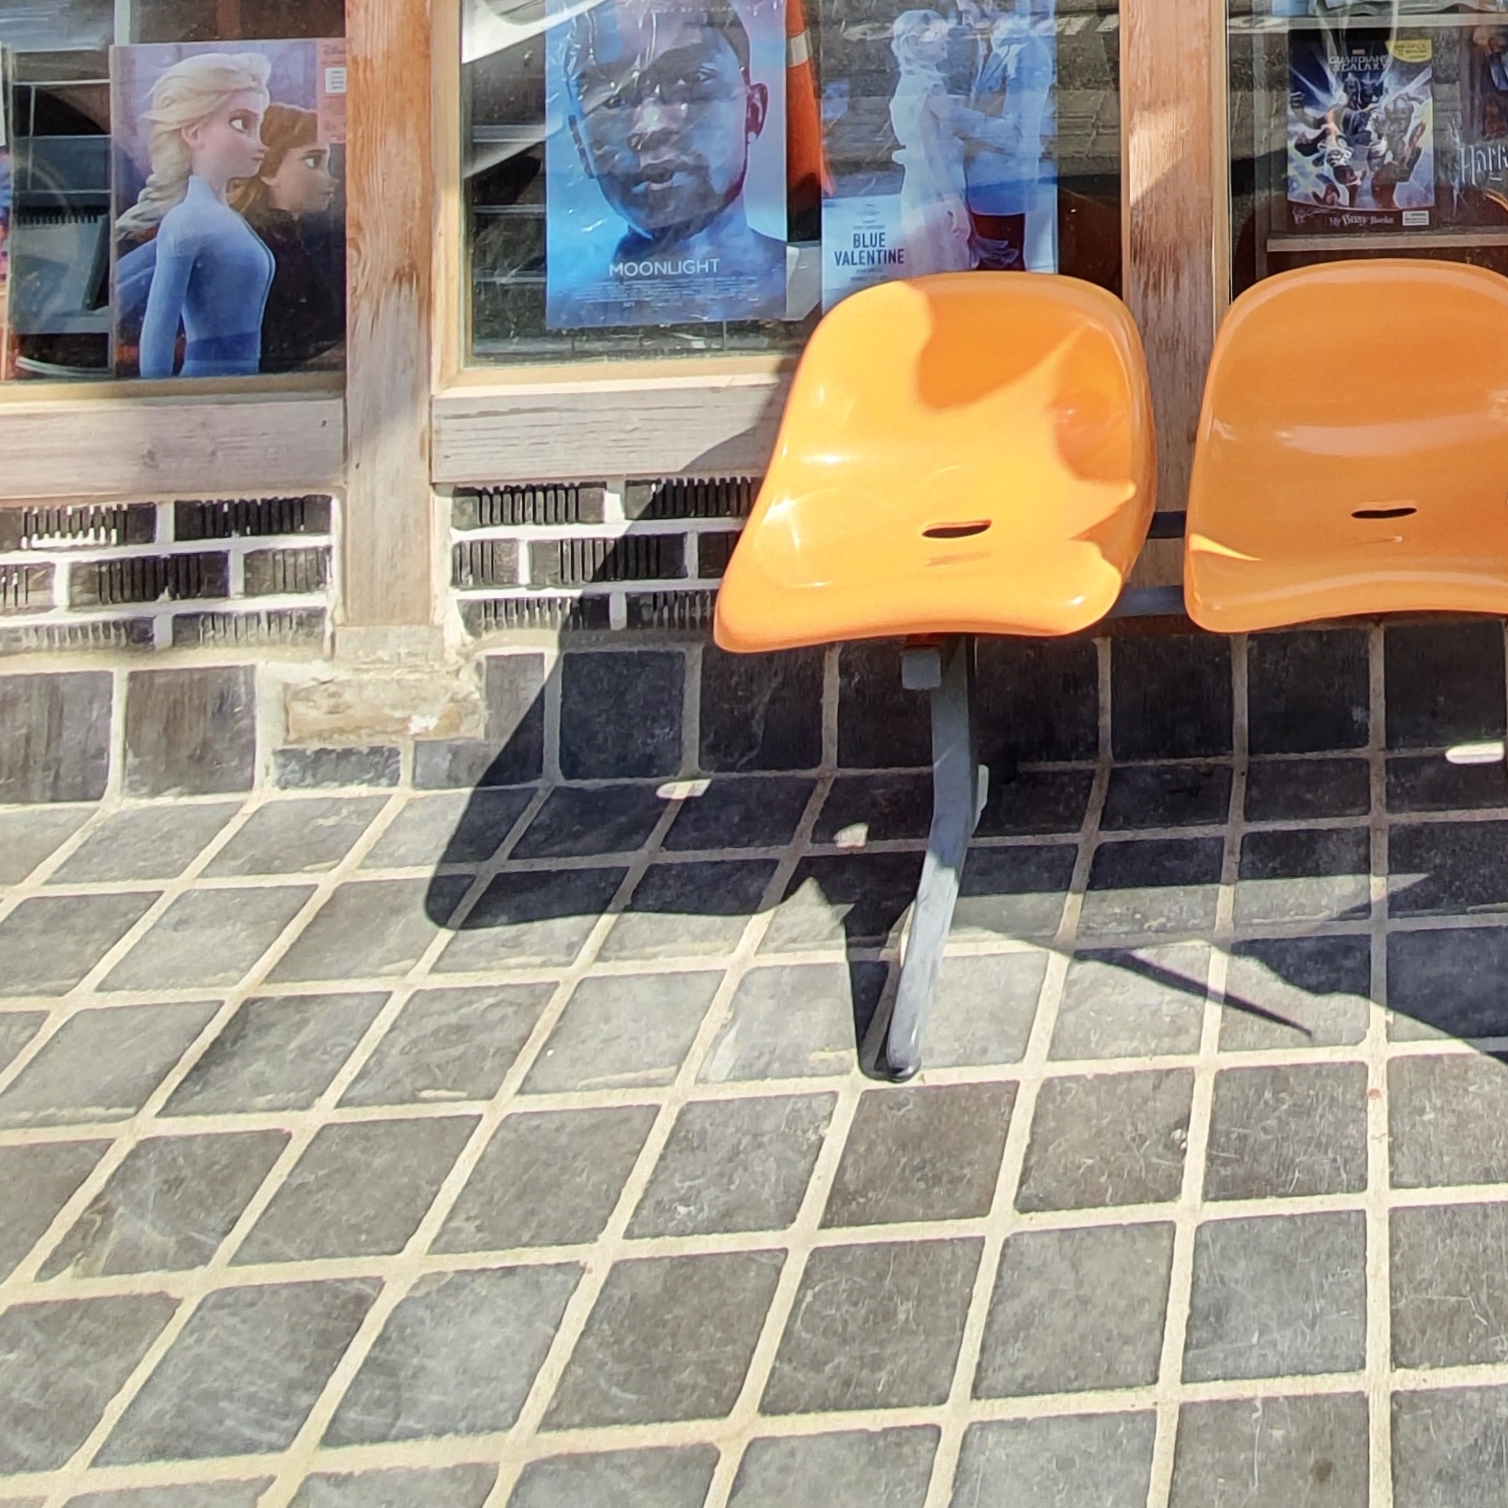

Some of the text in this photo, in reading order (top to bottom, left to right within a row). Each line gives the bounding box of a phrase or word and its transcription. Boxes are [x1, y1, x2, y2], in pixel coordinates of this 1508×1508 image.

[853, 232, 886, 249] BLUE
[834, 249, 905, 266] VALENTINE
[609, 258, 720, 277] MOONLIGHT
